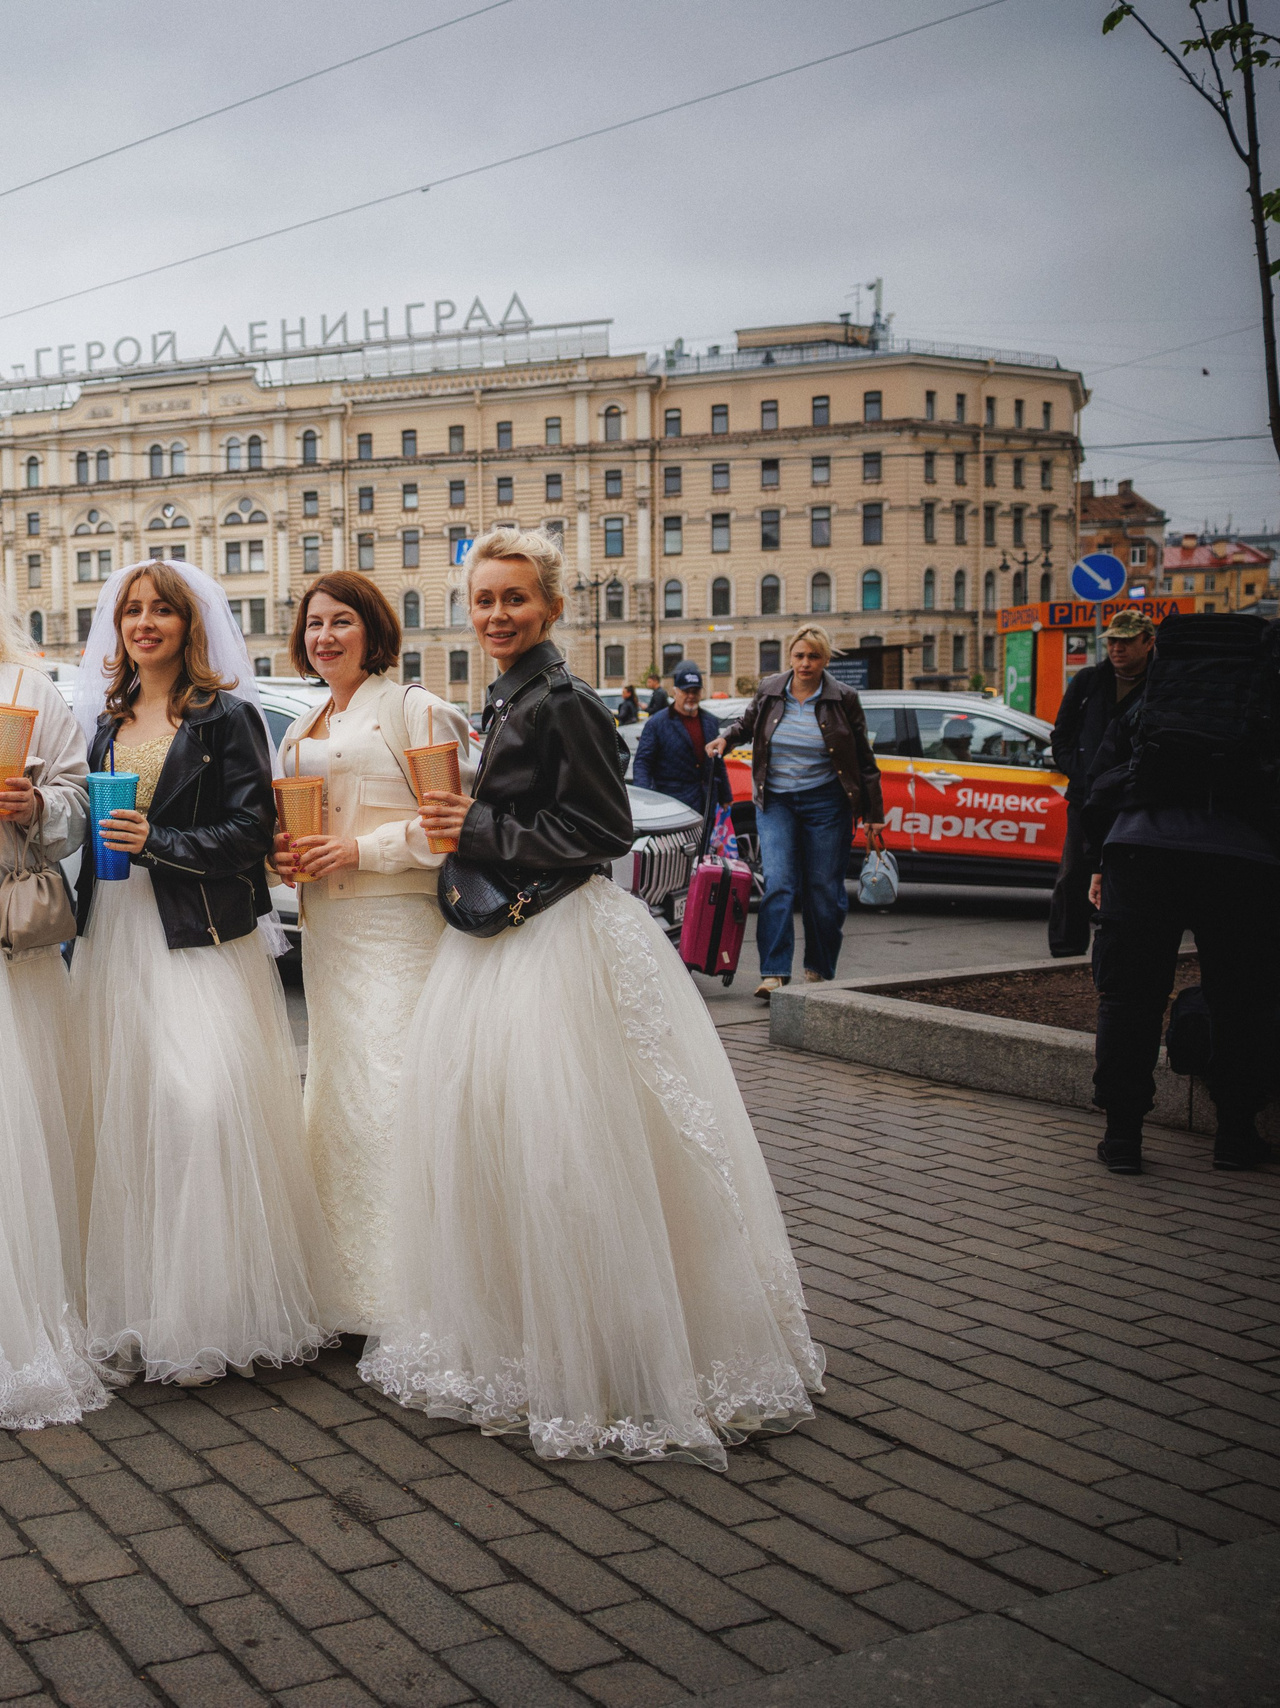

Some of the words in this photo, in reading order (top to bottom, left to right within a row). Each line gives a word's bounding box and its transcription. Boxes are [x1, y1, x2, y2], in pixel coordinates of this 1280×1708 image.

[213, 289, 533, 356] ЛЕНИНГРАД
[1054, 604, 1070, 624] P
[956, 788, 1049, 813] Яндекс
